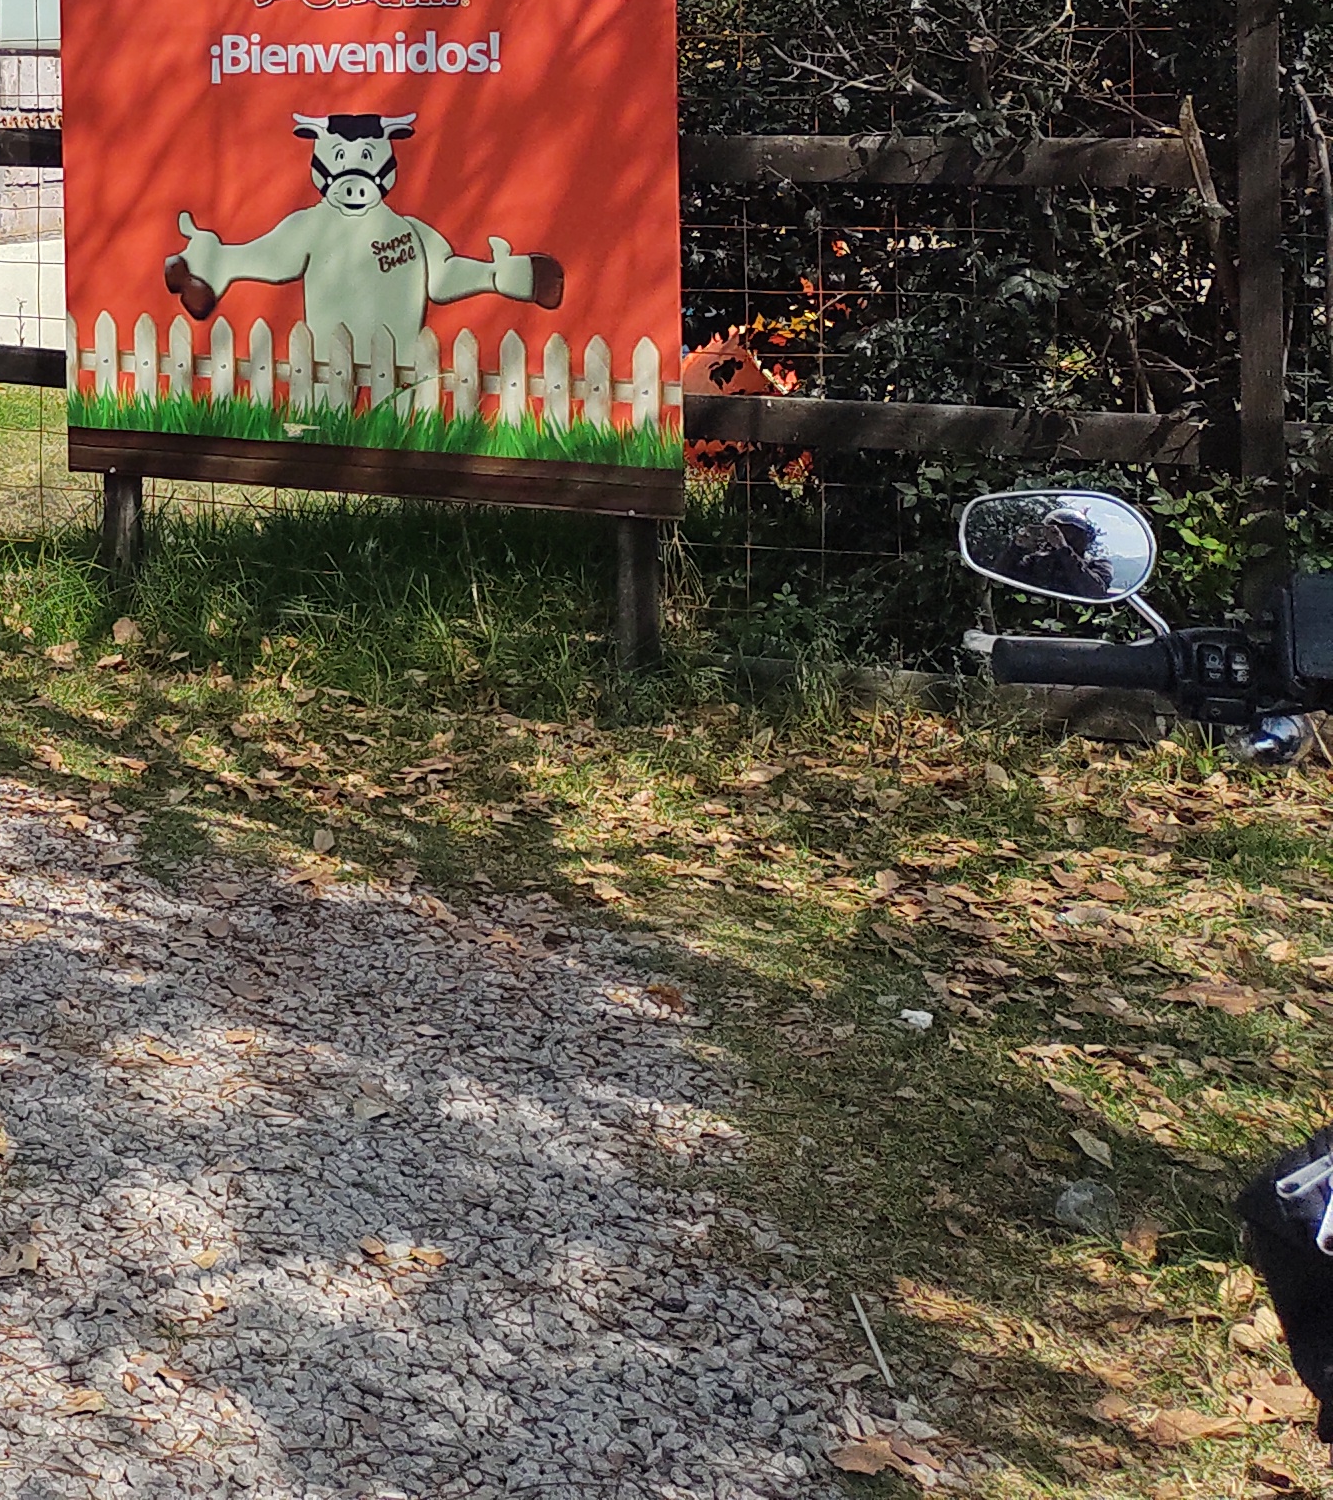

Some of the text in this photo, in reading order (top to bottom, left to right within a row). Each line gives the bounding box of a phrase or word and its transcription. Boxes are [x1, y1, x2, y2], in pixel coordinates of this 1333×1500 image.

[211, 31, 501, 84] ¡Bienvenidos!
[371, 232, 412, 255] Super
[378, 245, 416, 273] Bull
